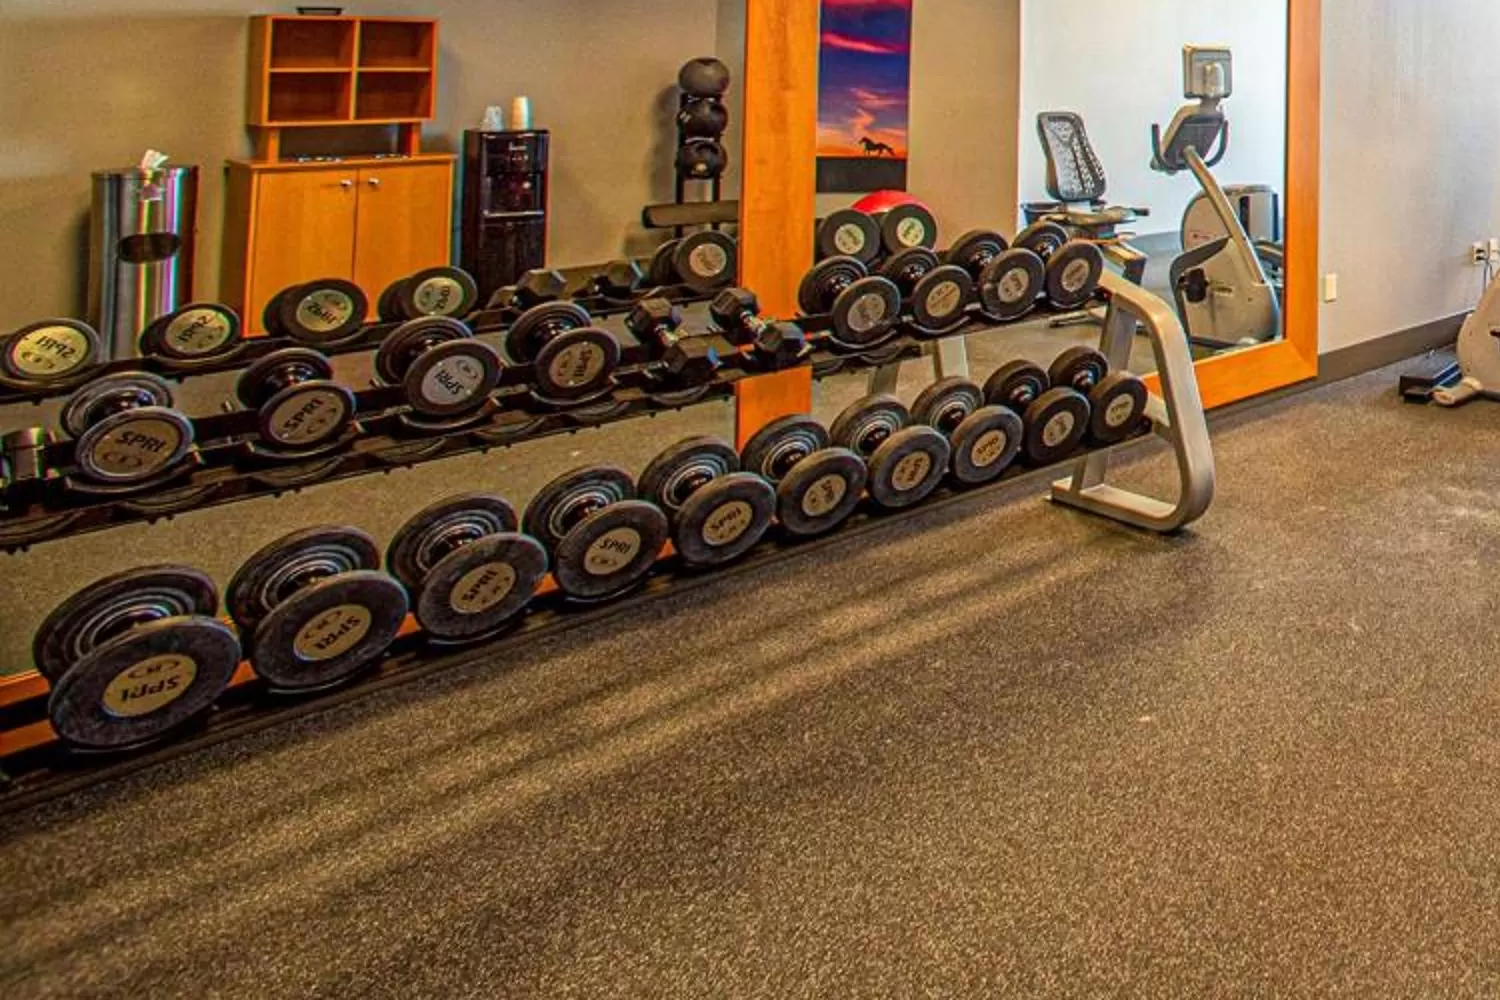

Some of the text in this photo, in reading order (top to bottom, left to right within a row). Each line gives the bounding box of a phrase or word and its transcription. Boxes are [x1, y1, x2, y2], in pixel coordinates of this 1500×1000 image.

[434, 368, 465, 396] SPRI
[283, 398, 325, 432] SPRI
[116, 430, 167, 453] SPRI
[710, 505, 742, 531] SPRI
[599, 537, 633, 555] SPRI
[461, 569, 499, 602] SPRI
[314, 615, 361, 650] SPRI
[121, 674, 182, 703] SPRI
